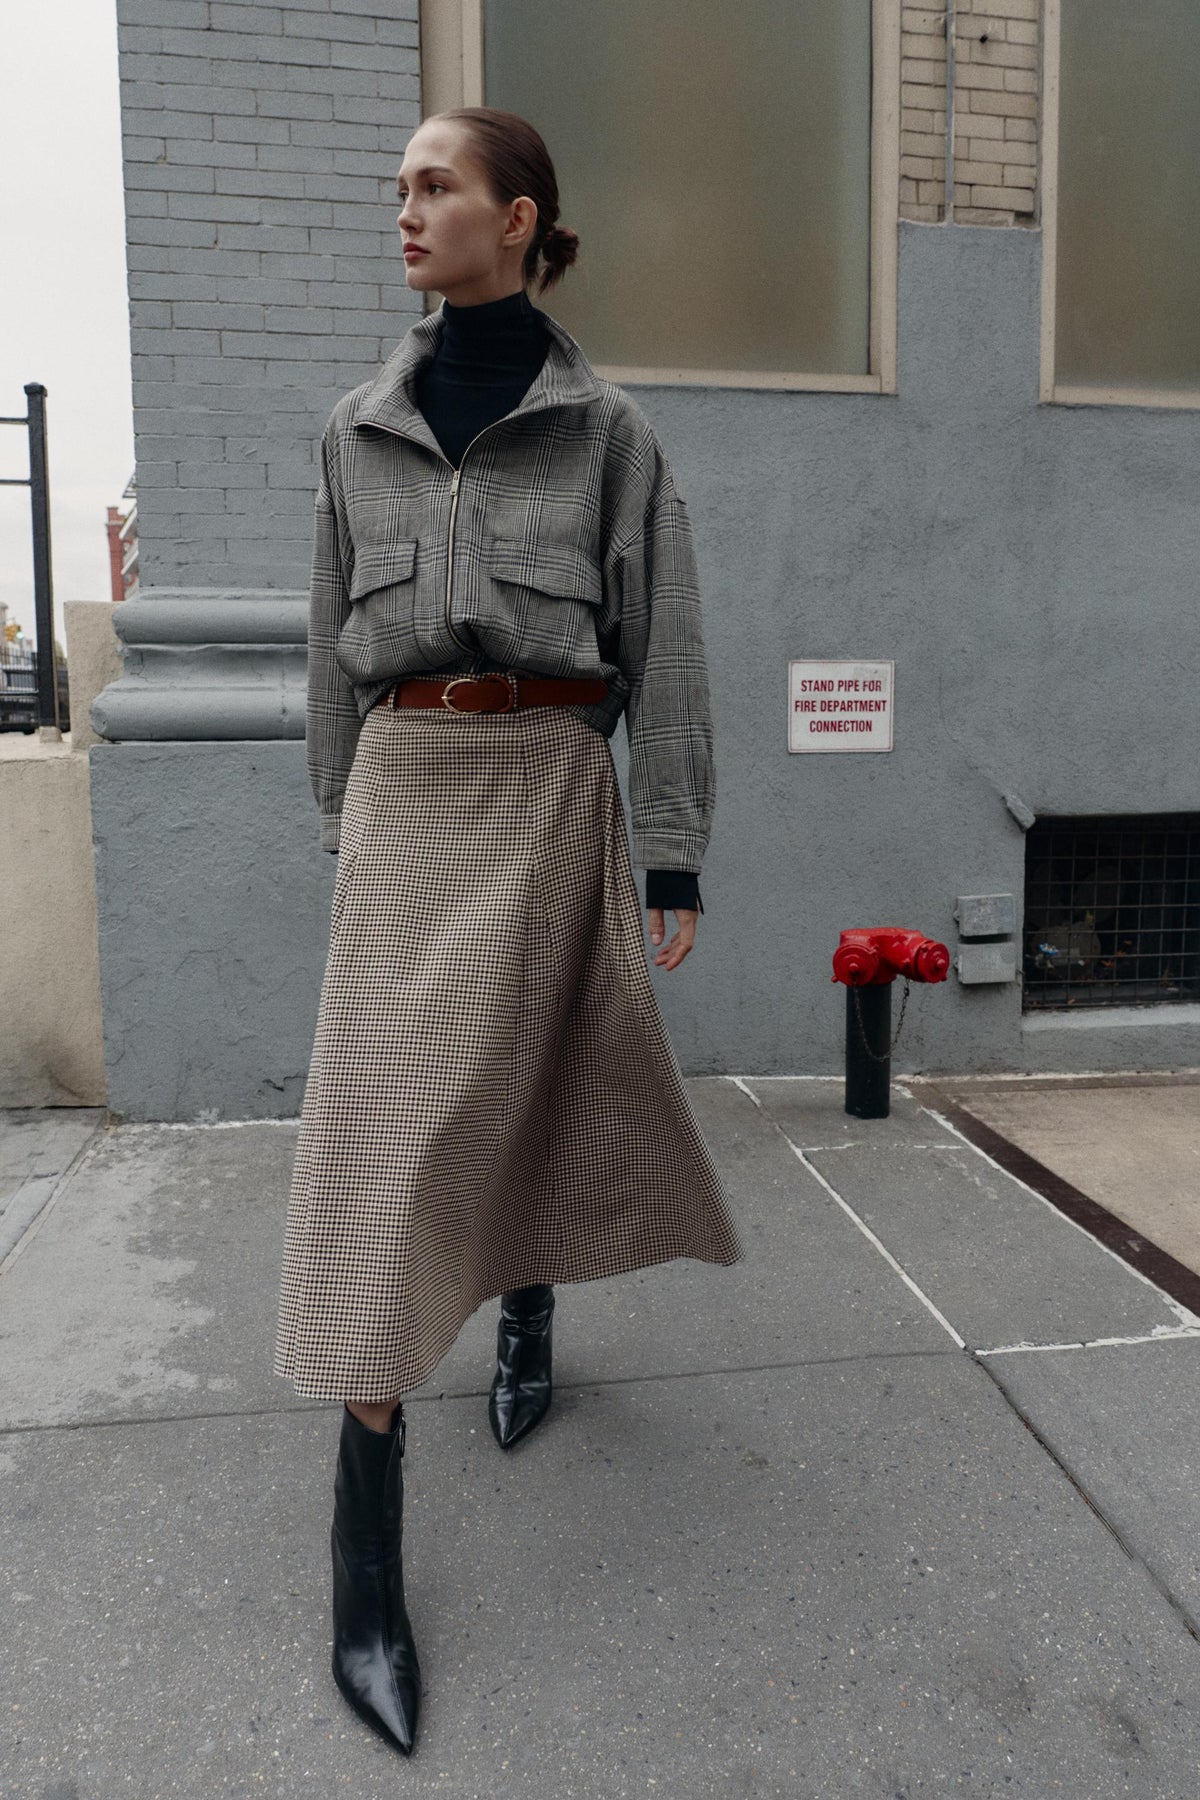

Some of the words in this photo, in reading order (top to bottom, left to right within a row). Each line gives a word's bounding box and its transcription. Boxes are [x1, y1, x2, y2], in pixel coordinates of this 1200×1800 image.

[801, 680, 834, 692] STAND
[837, 680, 859, 692] PIPE
[862, 680, 882, 692] FOR
[794, 700, 817, 712] FIRE
[820, 700, 887, 712] DEPARTMENT
[809, 720, 873, 732] CONNECTION
